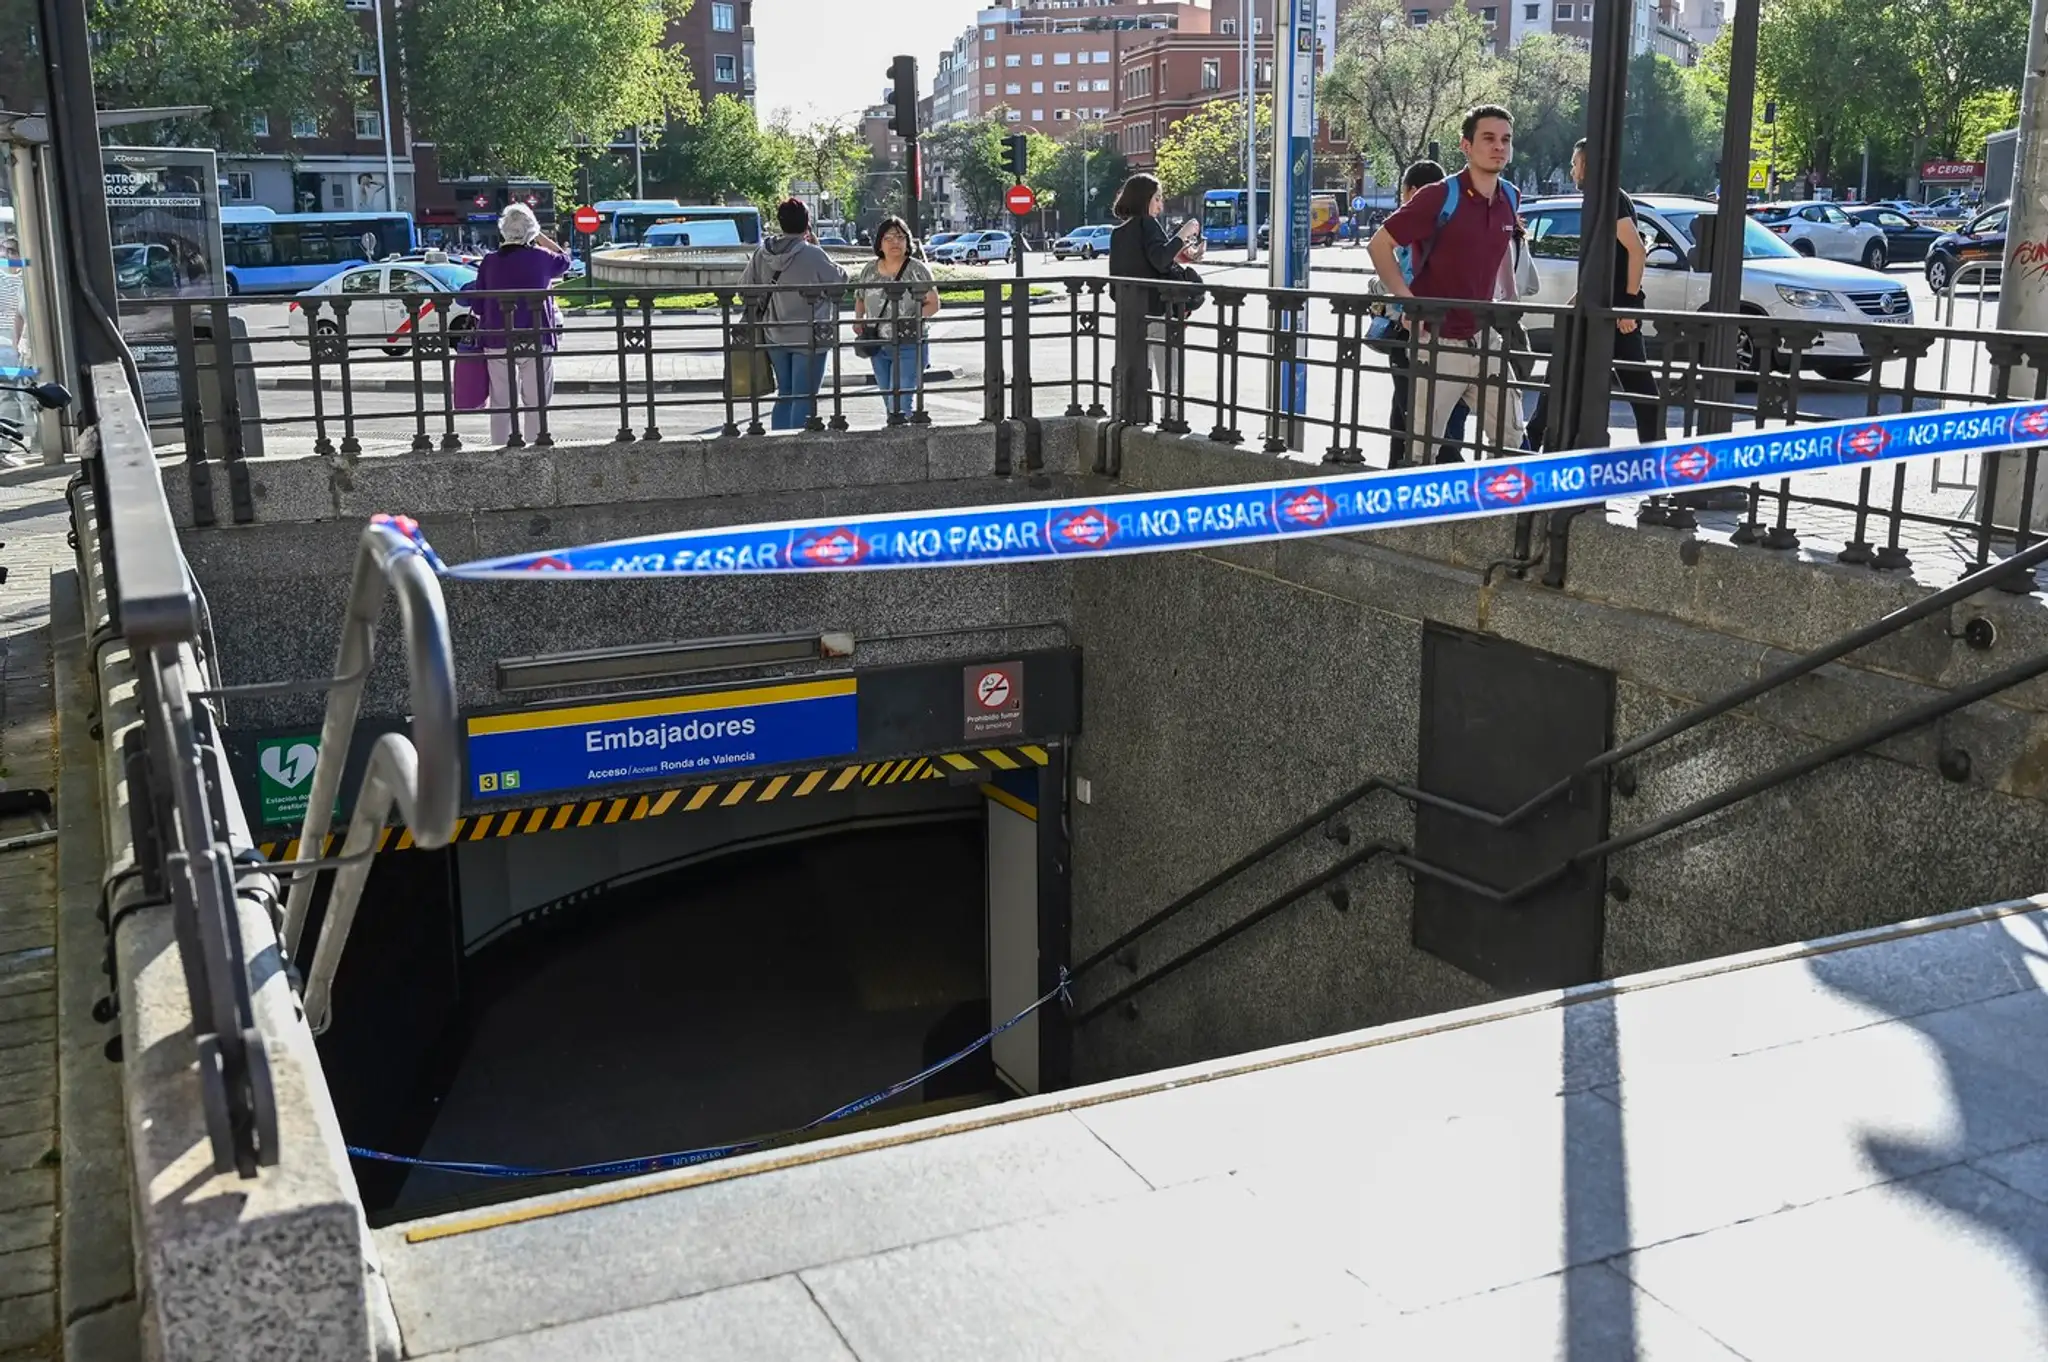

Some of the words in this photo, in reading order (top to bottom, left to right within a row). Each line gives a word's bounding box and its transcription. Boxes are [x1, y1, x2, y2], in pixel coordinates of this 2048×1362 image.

[1937, 165, 1974, 174] CEPSA
[105, 184, 138, 195] ROSS
[1907, 421, 1939, 446] NO
[1942, 415, 2006, 441] PASAR
[1732, 443, 1766, 469] NO
[1769, 435, 1834, 464] PASAR
[1550, 466, 1586, 492] NO
[1590, 457, 1657, 486] PASAR
[1355, 487, 1392, 517] NO
[1398, 479, 1471, 511] PASAR
[1140, 507, 1181, 537] NO
[1186, 501, 1269, 533] PASAR
[896, 527, 940, 558] NO
[949, 521, 1041, 553] PASAR
[967, 714, 999, 722] Prohibido
[1000, 711, 1020, 719] fumar
[985, 721, 1012, 729] smoking
[586, 718, 756, 753] Embajadores
[660, 759, 695, 771] Ronda
[697, 757, 710, 767] de
[712, 751, 756, 764] Valencia
[483, 775, 494, 788] 3
[504, 772, 515, 786] 5
[266, 795, 297, 804] Estación
